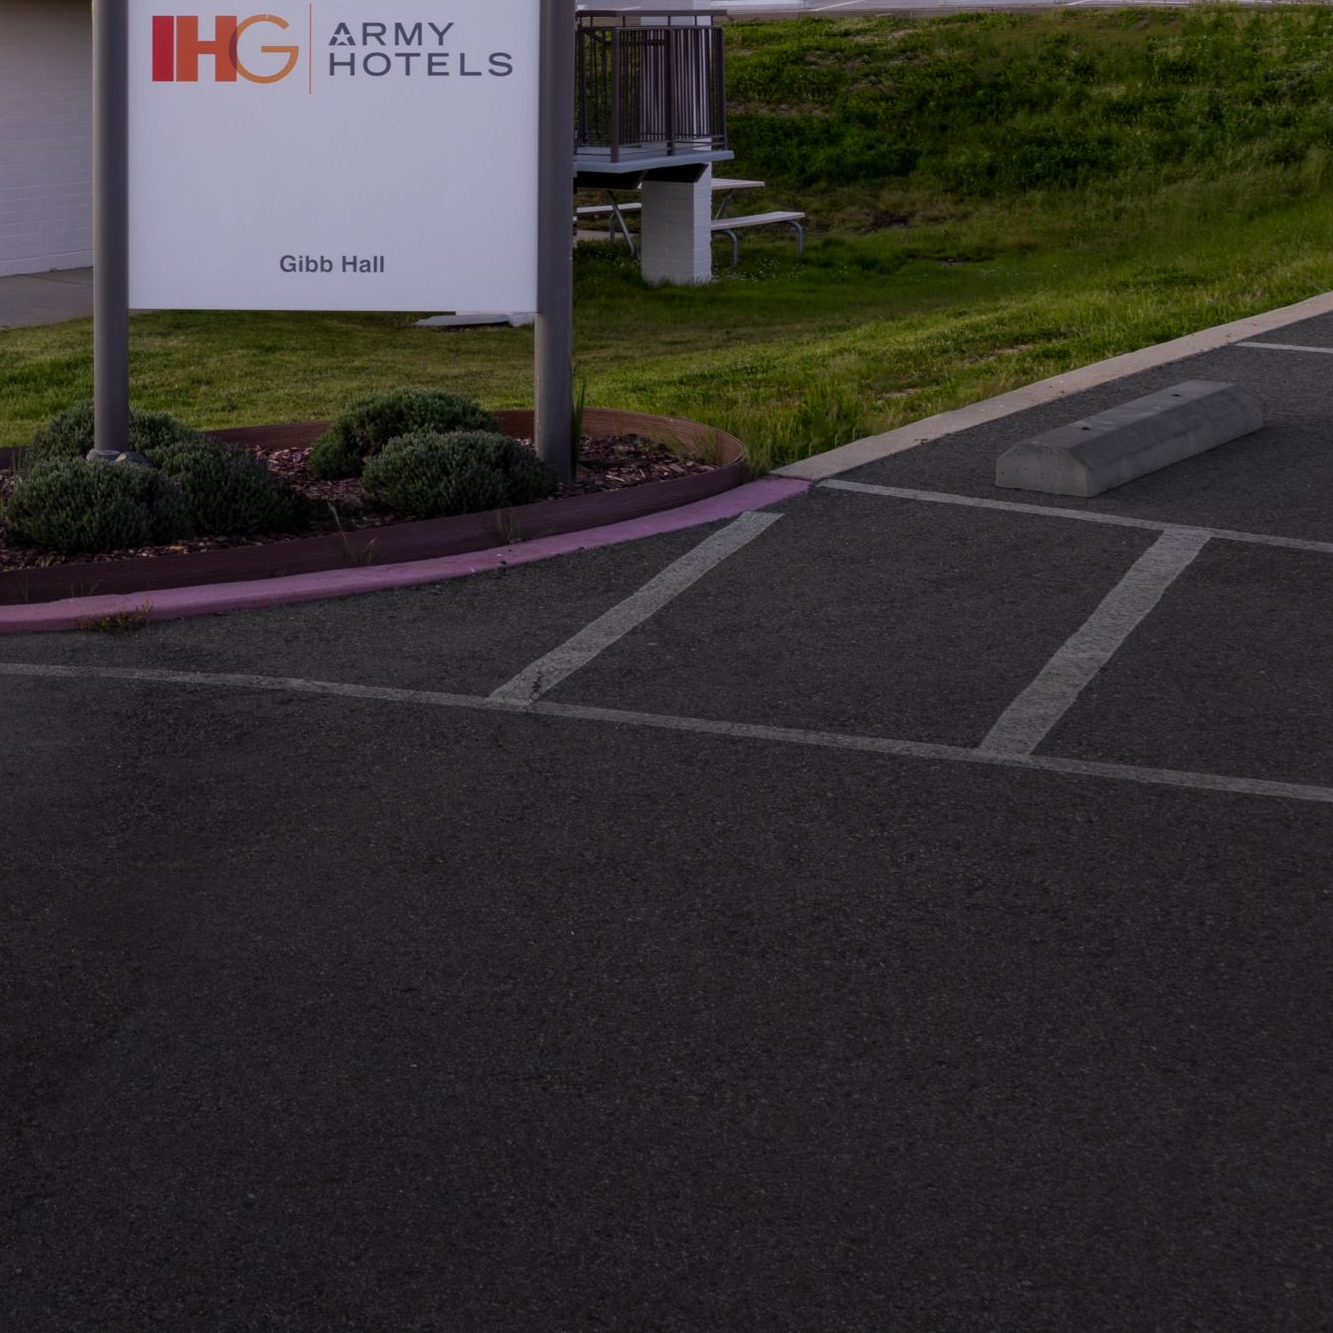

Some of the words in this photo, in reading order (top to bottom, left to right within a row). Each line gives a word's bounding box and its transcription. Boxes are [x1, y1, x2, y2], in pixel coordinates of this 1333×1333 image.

[328, 22, 455, 46] ARMY
[152, 14, 299, 84] IHG
[329, 52, 514, 77] HOTELS
[279, 255, 333, 274] Gibb
[341, 255, 385, 273] Hall
